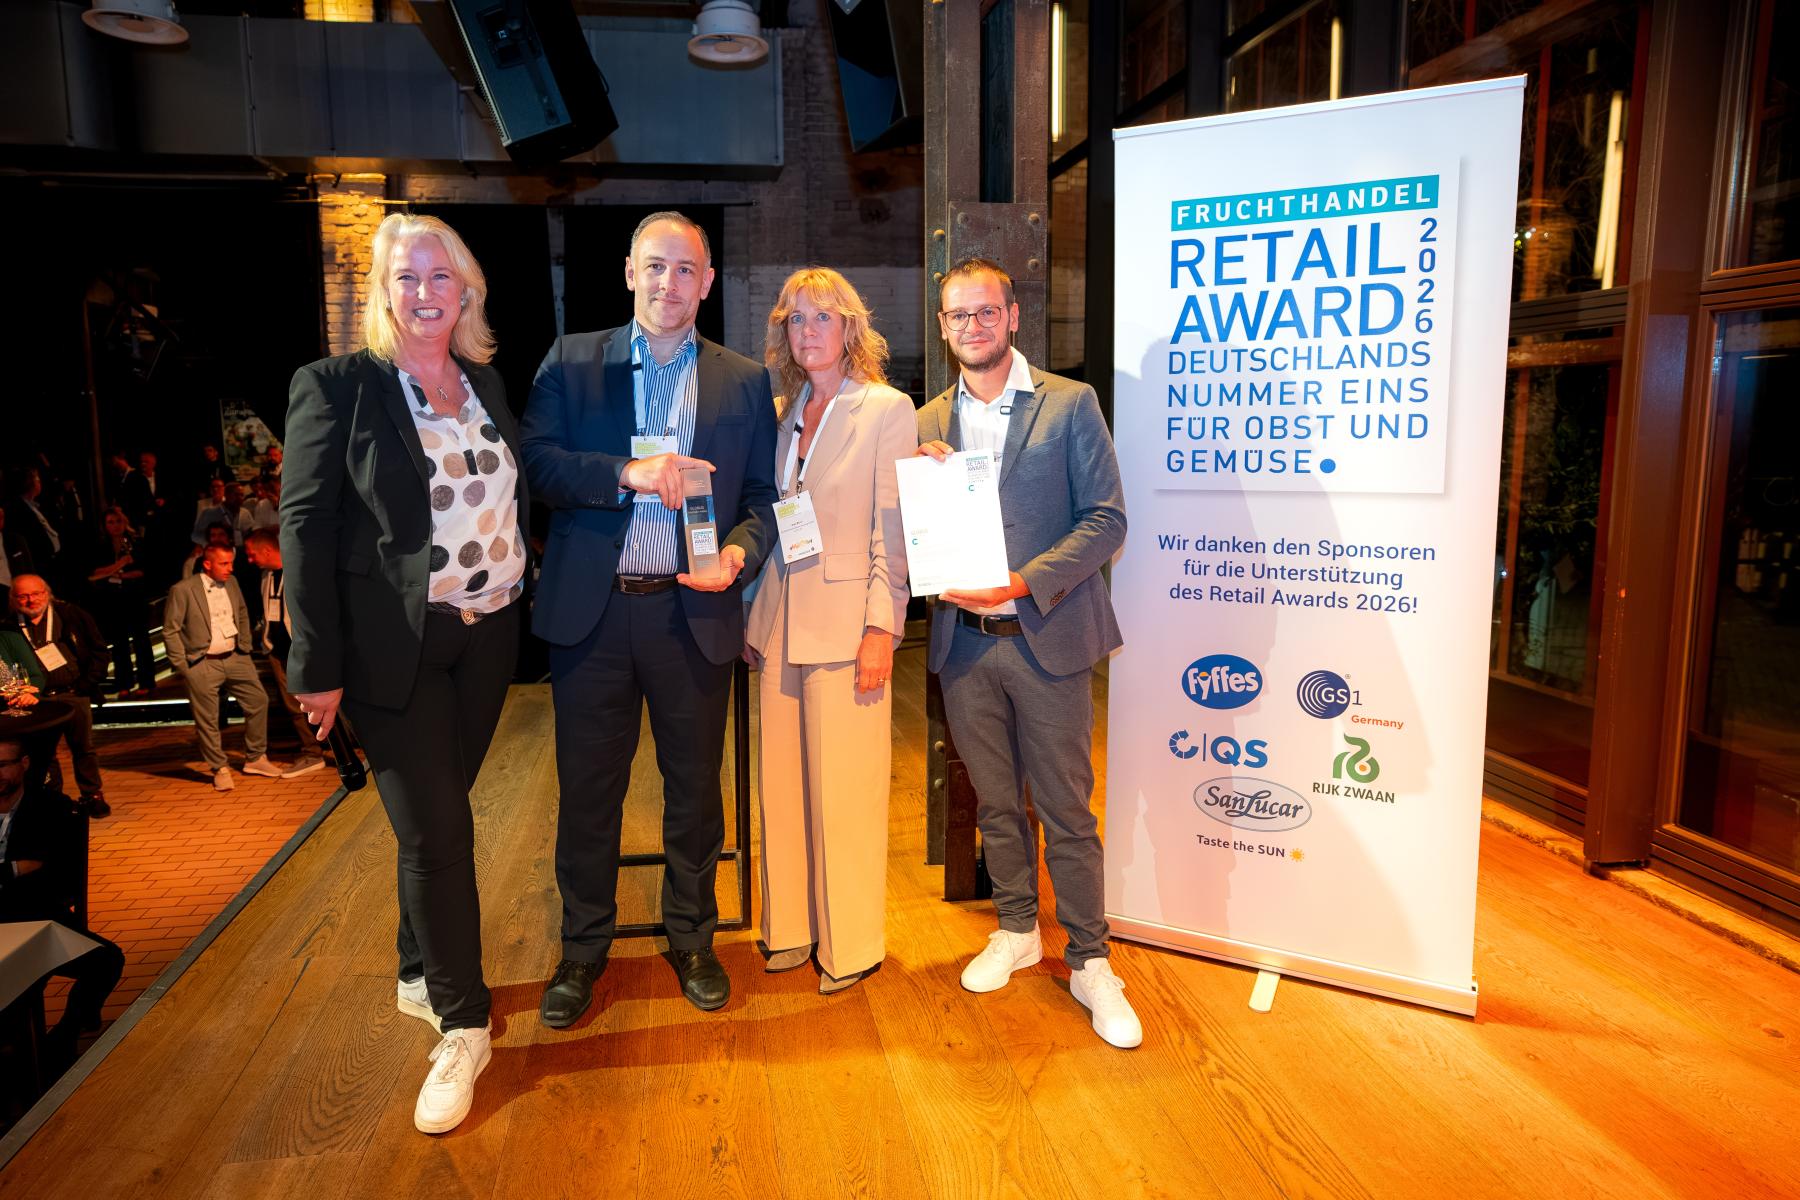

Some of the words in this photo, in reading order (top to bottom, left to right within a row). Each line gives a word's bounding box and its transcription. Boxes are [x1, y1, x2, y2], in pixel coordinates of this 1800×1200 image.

[1176, 183, 1431, 225] FRUCHTHANDEL
[1170, 222, 1406, 289] RETAIL
[1415, 217, 1438, 334] 2026
[1170, 283, 1404, 345] AWARD
[1168, 341, 1431, 375] DEUTSCHLANDS
[1168, 380, 1323, 407] NUMMER
[1341, 377, 1429, 404] EINS
[1167, 415, 1230, 440] FÜR
[1245, 415, 1335, 440] OBST
[1350, 413, 1429, 439] UND
[1158, 534, 1189, 551] Wir
[1195, 536, 1266, 554] danken
[1273, 538, 1310, 556] den
[1318, 540, 1436, 562] Sponsoren
[1183, 560, 1210, 577] für
[1216, 561, 1245, 578] die
[1252, 563, 1403, 590] Unterstützung
[1169, 583, 1203, 601] des
[1210, 586, 1265, 604] Retail
[1271, 590, 1348, 609] Awards
[1357, 593, 1418, 614] 2026!
[1187, 665, 1259, 700] fyffes
[1351, 715, 1404, 730] Germany
[1204, 785, 1304, 819] SanLucar
[1312, 782, 1340, 797] RIJK
[1344, 785, 1395, 804] ZWAAN
[1196, 834, 1230, 849] Taste
[1233, 840, 1254, 852] the
[1258, 844, 1285, 858] SUN
